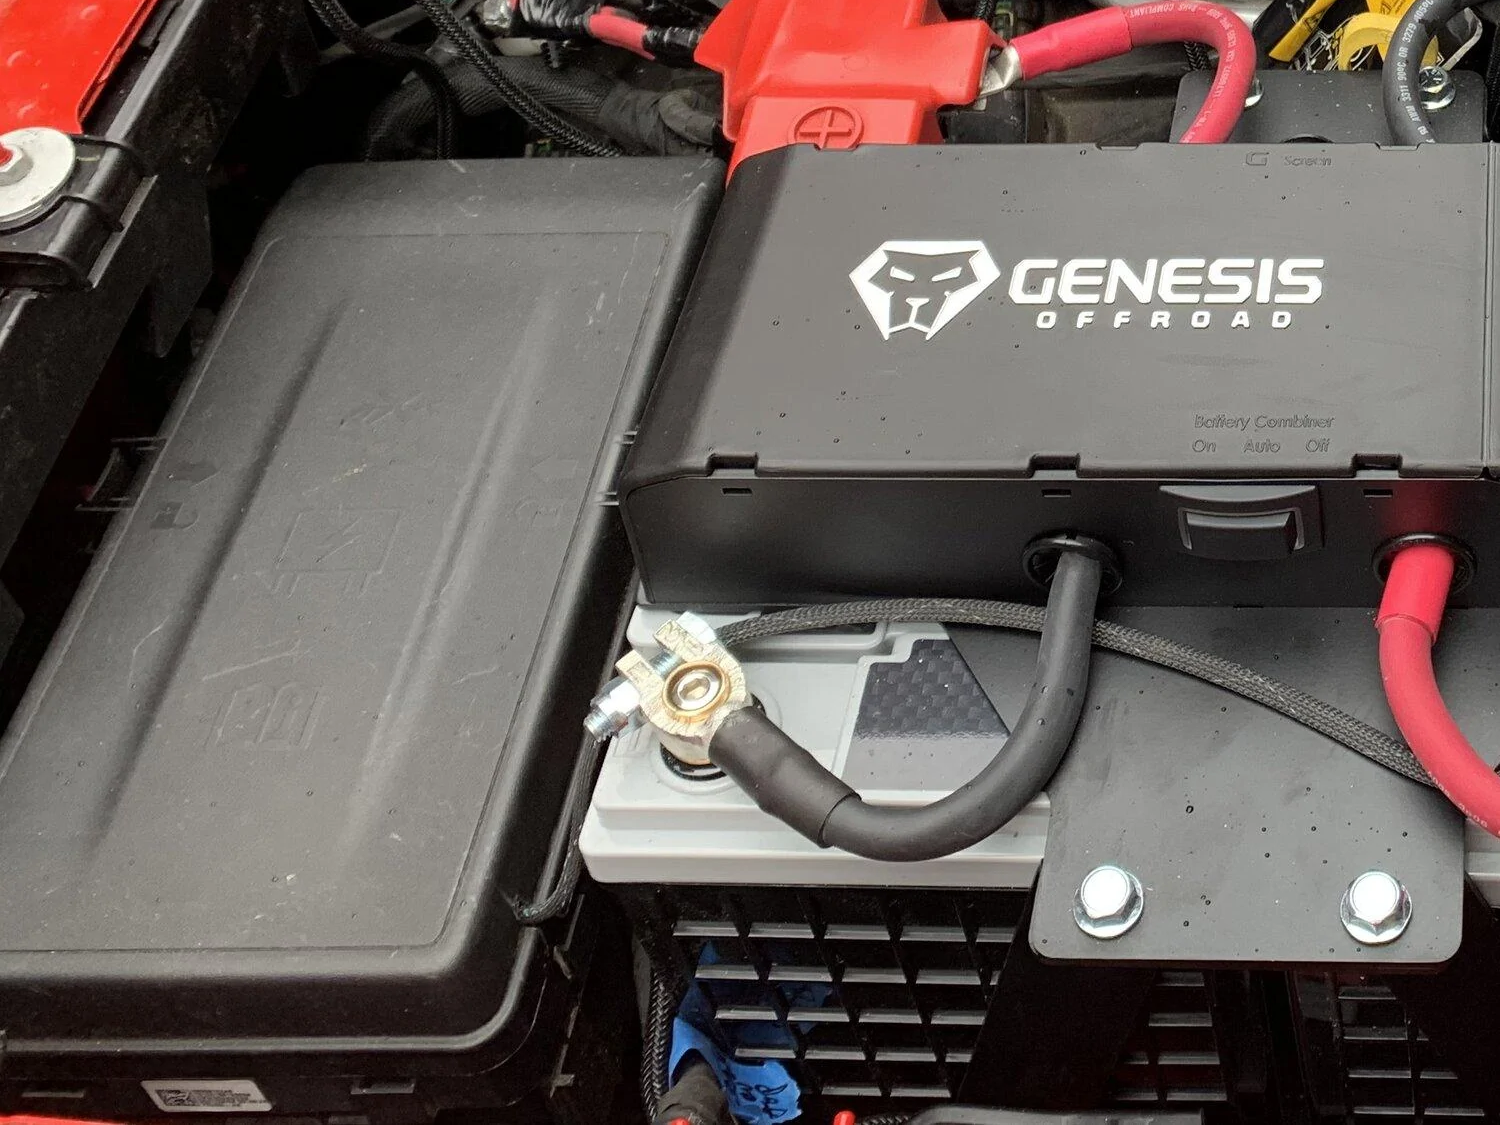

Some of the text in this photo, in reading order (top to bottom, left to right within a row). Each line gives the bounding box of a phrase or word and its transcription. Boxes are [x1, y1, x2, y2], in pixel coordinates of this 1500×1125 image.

[1129, 3, 1176, 19] COMPLIANT
[1402, 22, 1417, 43] 3279
[1400, 84, 1413, 102] 3311
[1405, 103, 1420, 122] AWM
[1284, 155, 1332, 167] Screen
[1008, 257, 1326, 305] GENESIS
[1036, 311, 1293, 330] OFFROAD
[1194, 414, 1335, 431] Battery Combiner
[1192, 437, 1330, 453] On Auto Off
